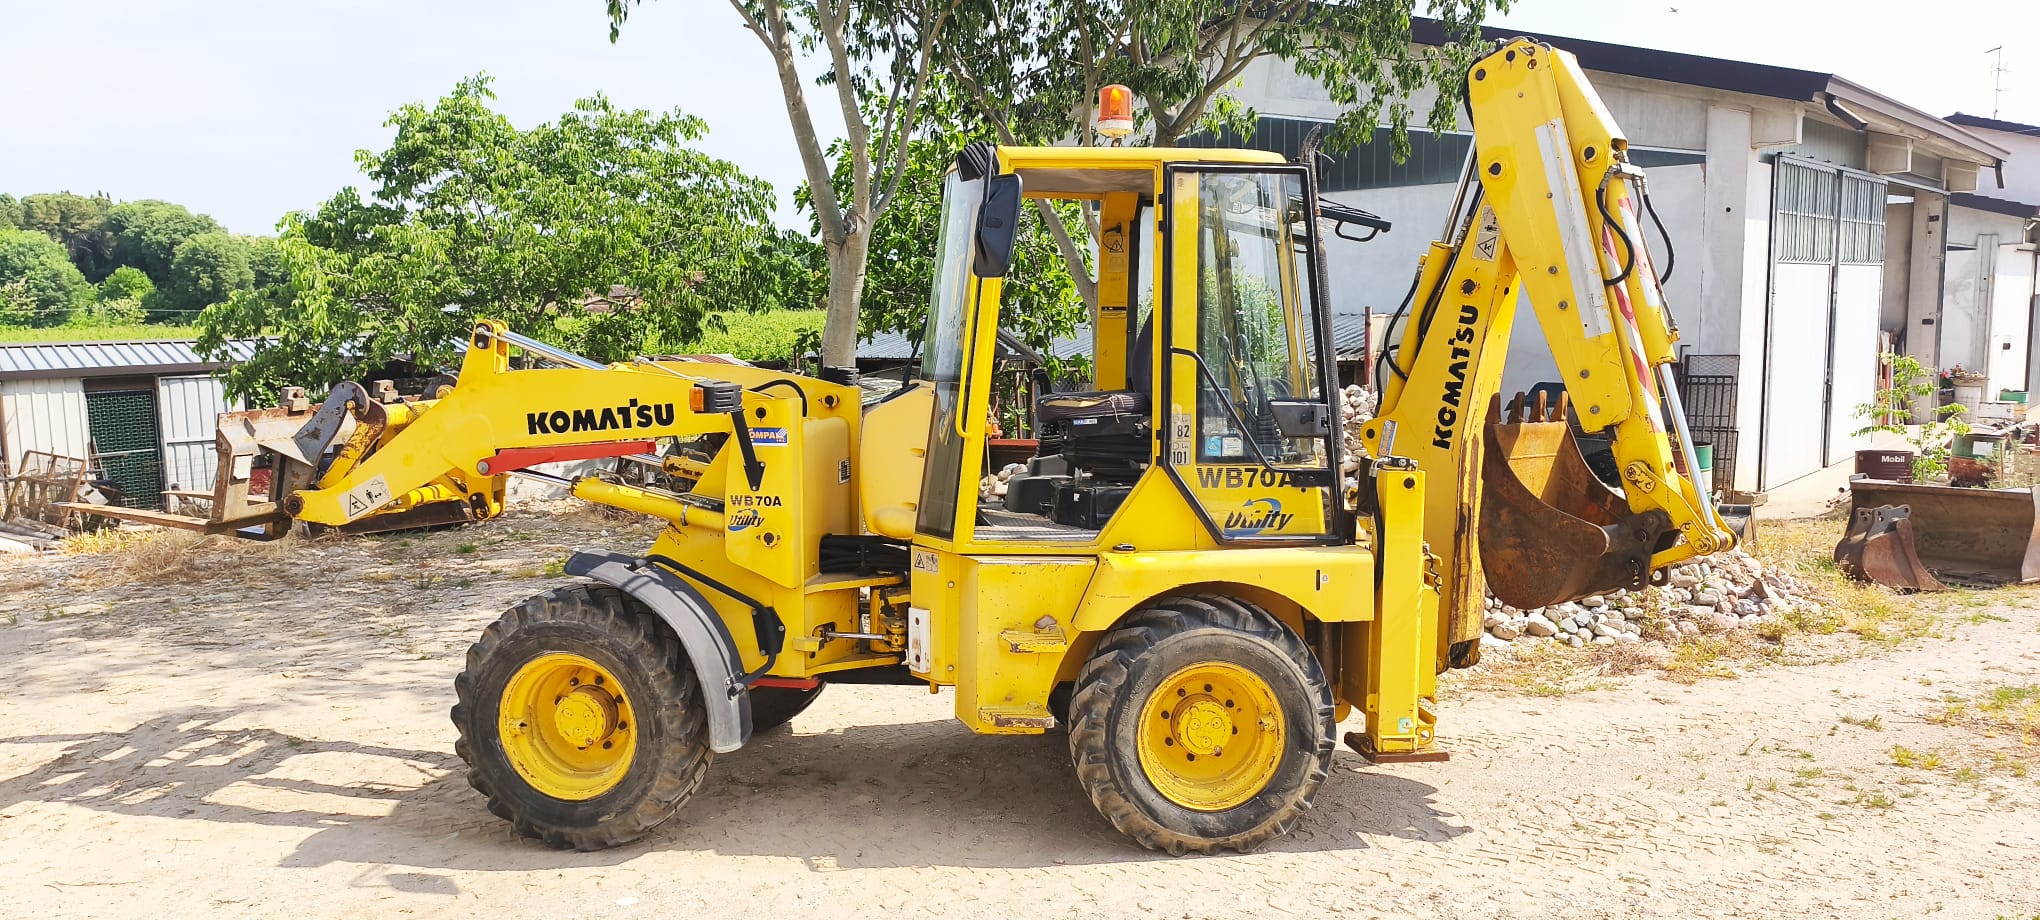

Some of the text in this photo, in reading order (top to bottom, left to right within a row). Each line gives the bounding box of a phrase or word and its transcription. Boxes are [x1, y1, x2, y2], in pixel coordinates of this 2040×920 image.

[1432, 304, 1479, 450] KOMATSU
[526, 398, 675, 435] KOMATSU
[1177, 424, 1190, 438] 82
[1172, 451, 1187, 464] 101
[1881, 455, 1906, 463] Mobil
[729, 514, 765, 528] Utility
